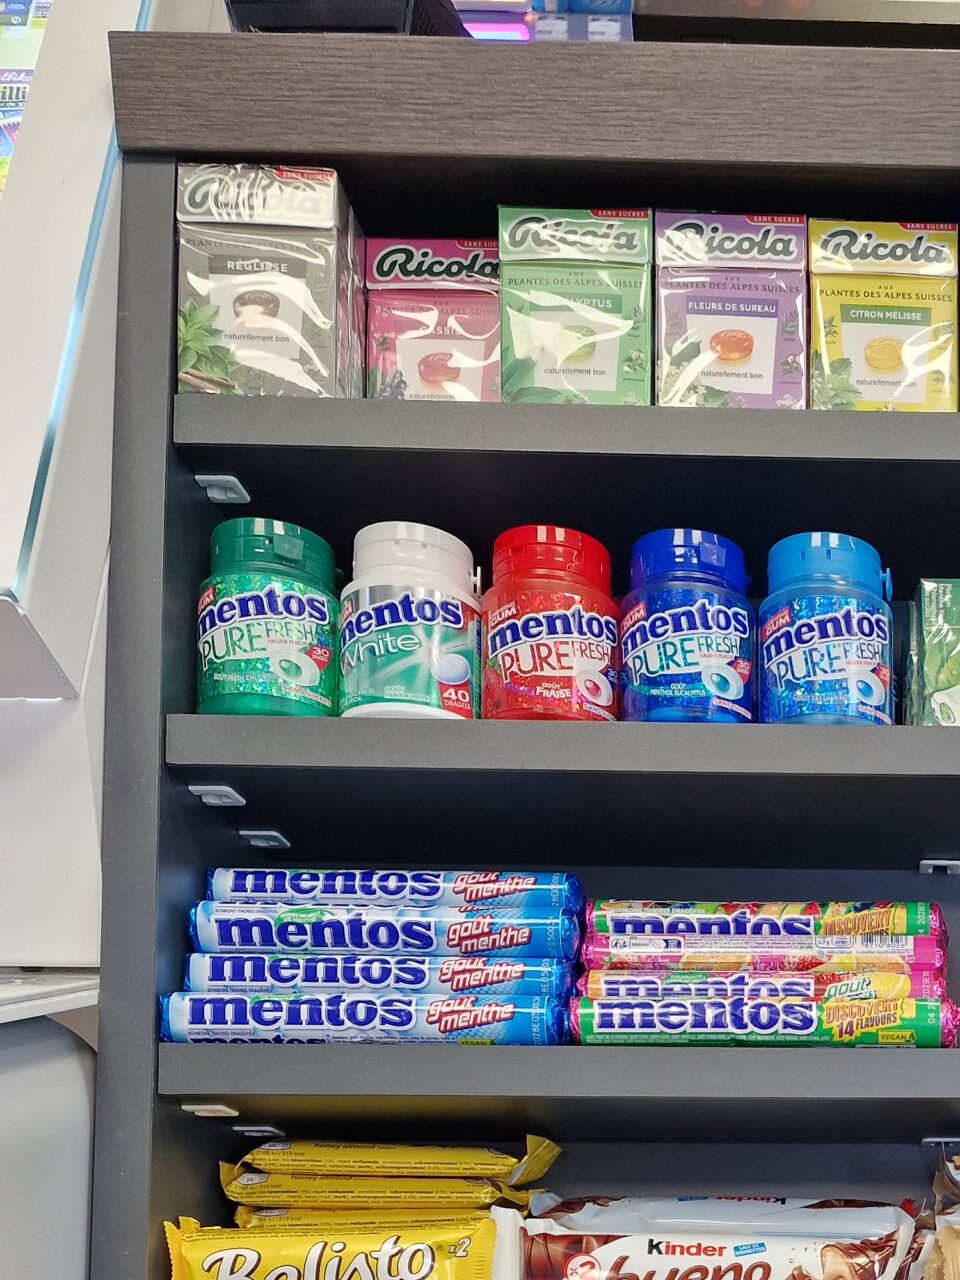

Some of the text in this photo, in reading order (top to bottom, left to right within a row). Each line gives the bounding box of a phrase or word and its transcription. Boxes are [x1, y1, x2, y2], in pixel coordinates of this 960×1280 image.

[509, 217, 638, 250] Ricola
[821, 230, 947, 262] Ricola
[376, 248, 499, 278] Ricola
[508, 278, 550, 286] PLANTES
[575, 279, 604, 287] ALPES
[665, 281, 800, 293] PLANTES DES ALPES SUISSES
[688, 302, 776, 313] FLEURS DE SUREAU
[819, 289, 860, 298] PLANTES
[884, 292, 912, 300] ALPES
[916, 293, 953, 302] SUISSES
[850, 310, 922, 320] CITRON MÉLISSE
[223, 332, 290, 343] naturellement bon
[544, 367, 607, 376] naturellement bon
[701, 371, 748, 379] naturellement
[490, 606, 518, 625] GUM
[490, 605, 617, 651] mentos
[766, 615, 791, 636] GUM
[623, 599, 749, 658] mentos
[764, 608, 888, 663] mentos
[202, 621, 315, 668] PURE FRESH
[312, 647, 329, 657] 30
[501, 640, 611, 683] PURE FRESH
[632, 634, 738, 685] PURE FRESH
[737, 661, 750, 669] 30
[776, 642, 880, 690] PURE FRESH
[442, 689, 470, 702] 40
[535, 687, 572, 698] FRAISE
[542, 682, 561, 690] GOÛT
[670, 682, 686, 690] GOÛT
[231, 869, 442, 898] mentos
[465, 877, 536, 901] menthe
[215, 912, 434, 951] mentos
[448, 915, 491, 945] goût
[611, 910, 811, 935] mentos
[822, 909, 892, 935] DISCOVERY
[462, 926, 530, 952] menthe
[208, 954, 428, 986] mentos
[452, 962, 525, 991] menthe
[604, 974, 812, 997] mentos
[188, 994, 414, 1027] mentos
[440, 1003, 515, 1032] menthe
[597, 997, 815, 1030] mentos
[825, 999, 898, 1024] DISCOVERY
[836, 1021, 855, 1039] 14
[856, 1012, 897, 1031] FLAVOURS
[448, 1237, 472, 1258] x2
[647, 1238, 727, 1259] Kinder
